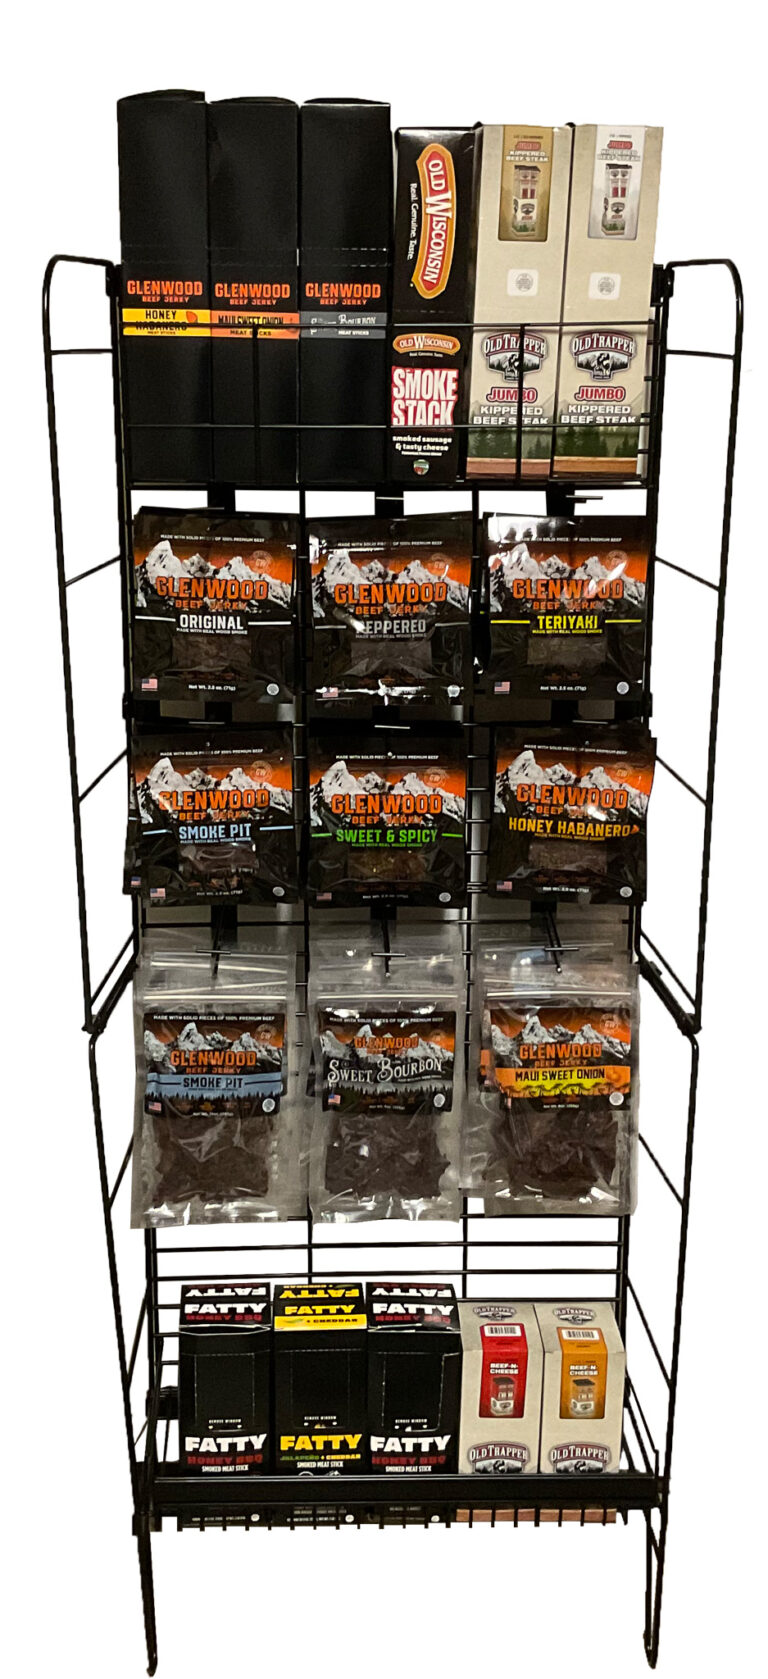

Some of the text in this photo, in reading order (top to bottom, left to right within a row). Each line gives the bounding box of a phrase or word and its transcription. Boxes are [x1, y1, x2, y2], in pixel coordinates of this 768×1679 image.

[422, 159, 453, 285] OLD WISCONSIN
[127, 280, 202, 296] GLENWOOD
[215, 283, 290, 298] GLENWOOD
[306, 282, 381, 298] GLENWOOD
[146, 310, 176, 320] HONEY
[400, 336, 454, 349] OLD WISCONSIN
[484, 338, 502, 354] OLD
[572, 333, 635, 354] OLD TRAPPER
[392, 368, 458, 400] SMOKE
[576, 388, 624, 401] JUMBO
[392, 400, 454, 427] STACK
[568, 404, 630, 414] KIPPERED
[473, 416, 549, 425] BEEF SEAK
[561, 415, 636, 424] BEEF STEAK
[403, 444, 422, 452] tasty
[155, 576, 269, 600] GLENWOOD
[334, 582, 448, 604] GLENWOOD
[176, 600, 246, 610] BEEF JERKY
[356, 604, 428, 615] BEEF JERKY
[533, 602, 560, 610] BEEF
[180, 614, 244, 630] ORIGINAL
[537, 615, 598, 629] TERIYAKI
[159, 789, 270, 810] GLENWOOD
[517, 784, 628, 809] GLENWOOD
[331, 794, 443, 814] GLENWOOD
[536, 806, 563, 814] BEEF
[179, 812, 207, 820] BEEF
[352, 816, 379, 824] BEEF
[179, 823, 251, 840] SMOKE PIT
[509, 817, 553, 834] HONEY
[557, 821, 630, 837] HABANERO
[336, 829, 438, 843] SWEET & SPICY
[354, 1037, 418, 1048] GLENWOOD
[520, 1043, 602, 1059] GLENWOOD
[171, 1051, 256, 1066] GLENWOOD
[327, 1058, 442, 1087] SWEET BOURBON
[516, 1068, 605, 1081] MAUI SWEET ONION
[184, 1077, 243, 1088] SMOKE PIT
[185, 1287, 266, 1297] FATTY
[279, 1289, 359, 1298] FATTY
[372, 1288, 452, 1297] FATTY
[184, 1303, 267, 1314] FATTY
[285, 1305, 355, 1314] FATTY
[373, 1303, 454, 1316] FATTY
[185, 1434, 267, 1452] FATTY
[280, 1434, 362, 1450] FATTY
[370, 1434, 451, 1452] FATTY
[187, 1454, 263, 1464] HONEY BBQ
[470, 1444, 528, 1461] OLD TRAPPER
[551, 1445, 609, 1461] OLD TRAPPER
[419, 1456, 446, 1464] BBQ
